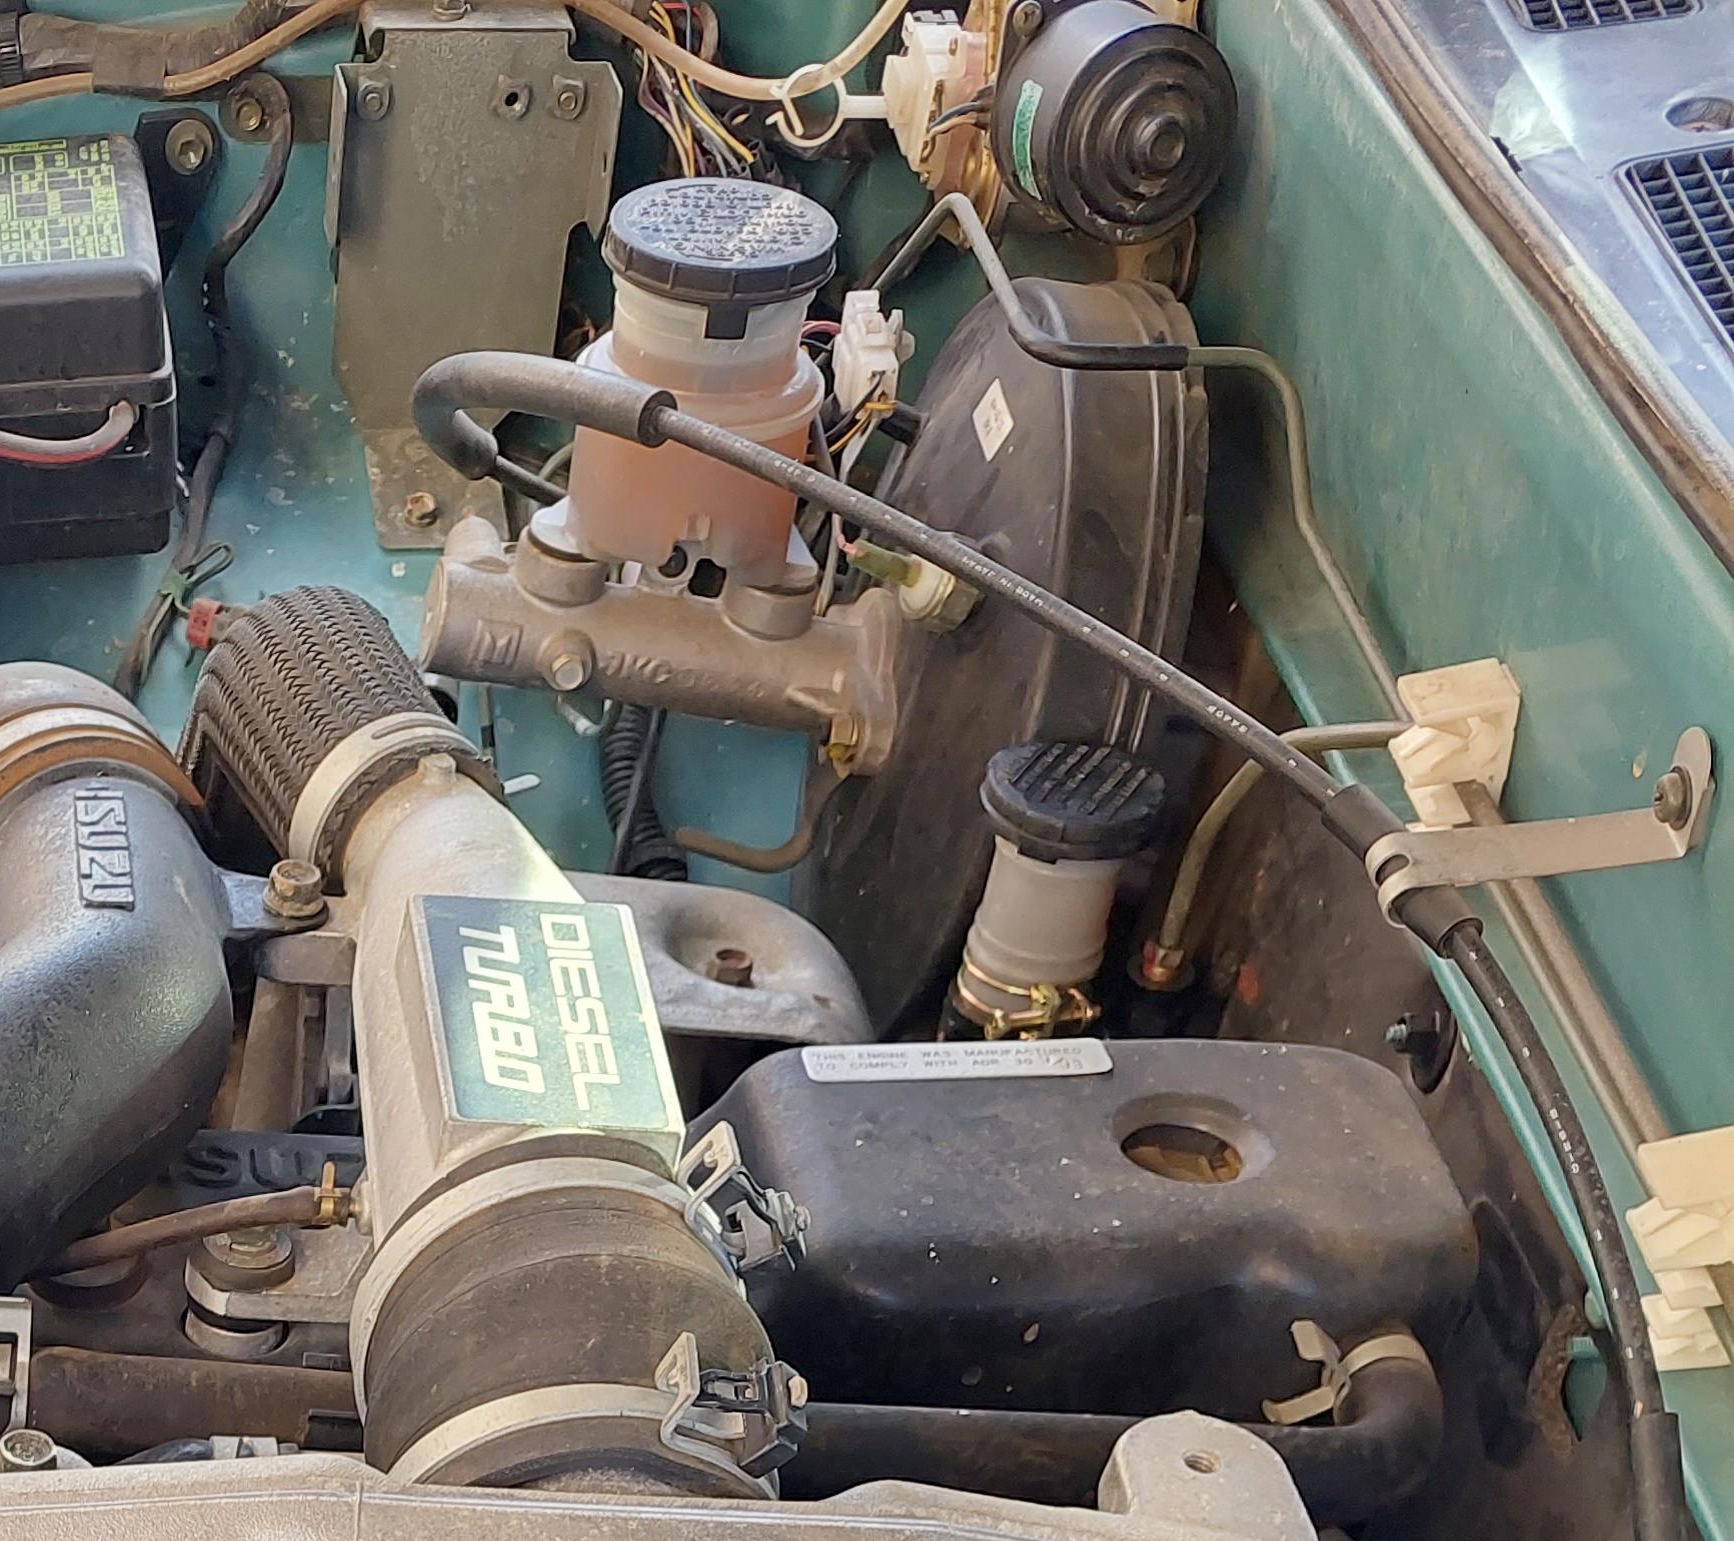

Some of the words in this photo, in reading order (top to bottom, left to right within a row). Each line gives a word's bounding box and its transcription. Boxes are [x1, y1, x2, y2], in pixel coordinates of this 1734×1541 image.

[74, 786, 134, 911] ISUZU
[458, 924, 545, 1094] TURBO
[539, 912, 620, 1111] DIESEL
